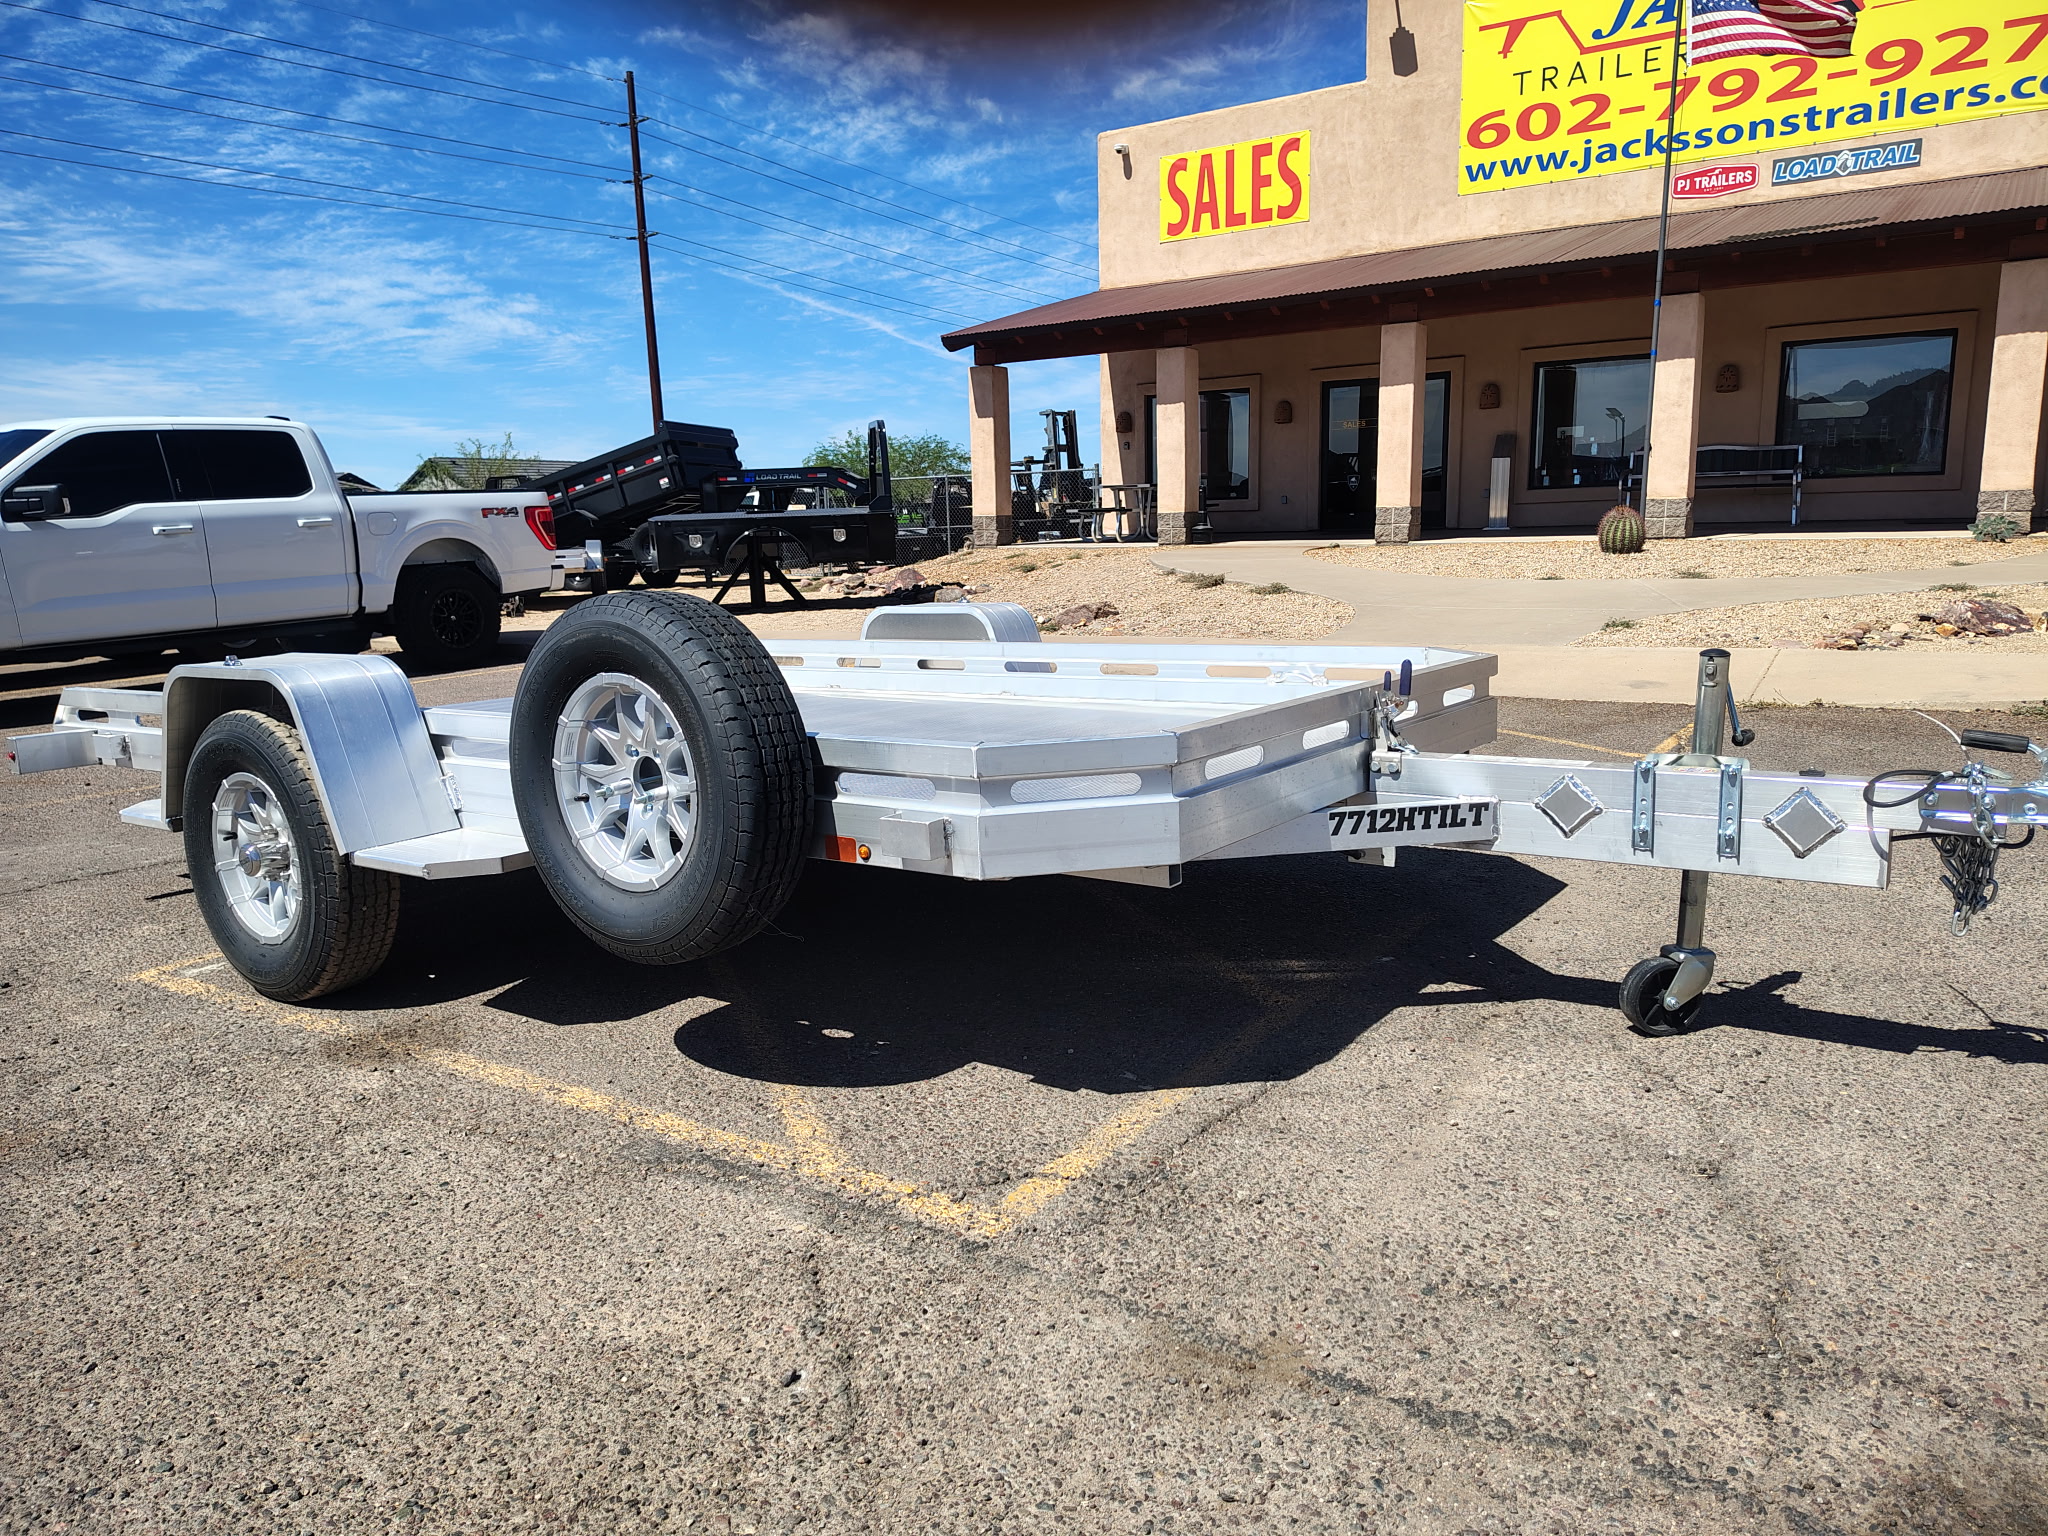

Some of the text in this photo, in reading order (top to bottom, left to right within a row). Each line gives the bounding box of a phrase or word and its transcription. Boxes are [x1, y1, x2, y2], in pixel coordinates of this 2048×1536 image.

[1465, 75, 2048, 182] www.jackssonstrailers.c
[1773, 143, 1920, 183] LOAD TRAIL
[1167, 137, 1302, 237] SALES
[1677, 170, 1753, 192] PJ TRAILERS
[1343, 421, 1366, 429] SALES
[481, 507, 519, 518] FX4
[1328, 802, 1490, 836] 7712HTILT
